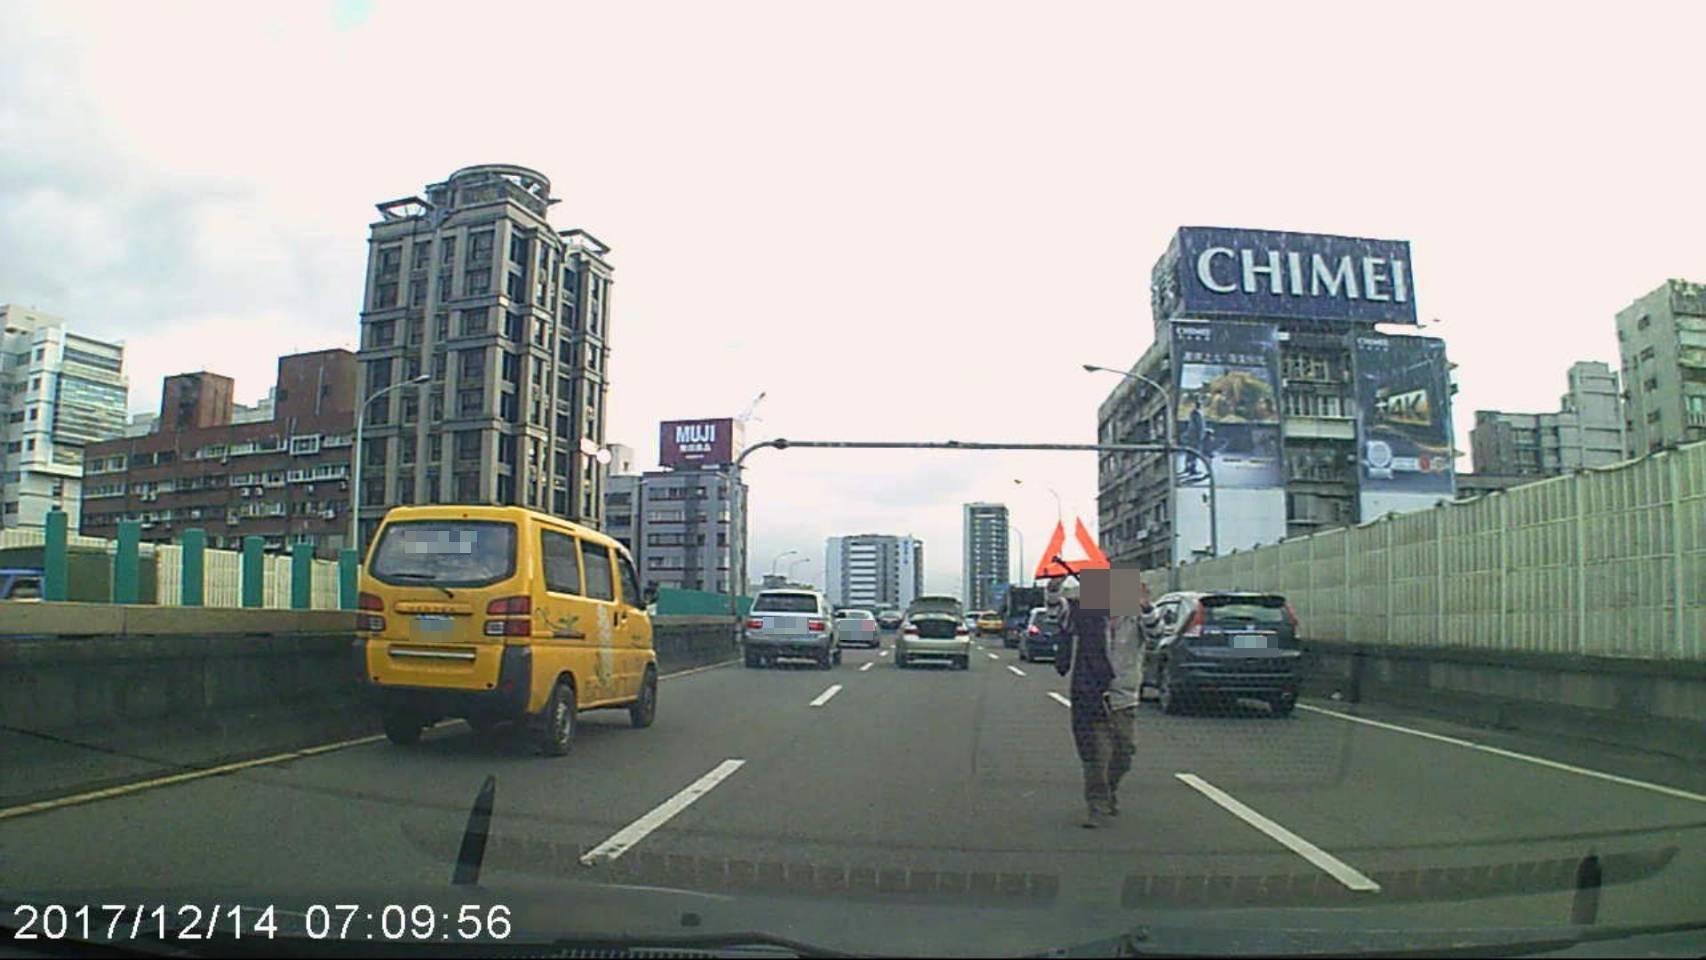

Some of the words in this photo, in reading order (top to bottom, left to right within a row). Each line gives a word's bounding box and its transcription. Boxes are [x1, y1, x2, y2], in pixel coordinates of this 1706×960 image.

[1196, 246, 1408, 302] CHIMEI
[1391, 394, 1424, 419] 4K
[675, 424, 716, 443] MUJI
